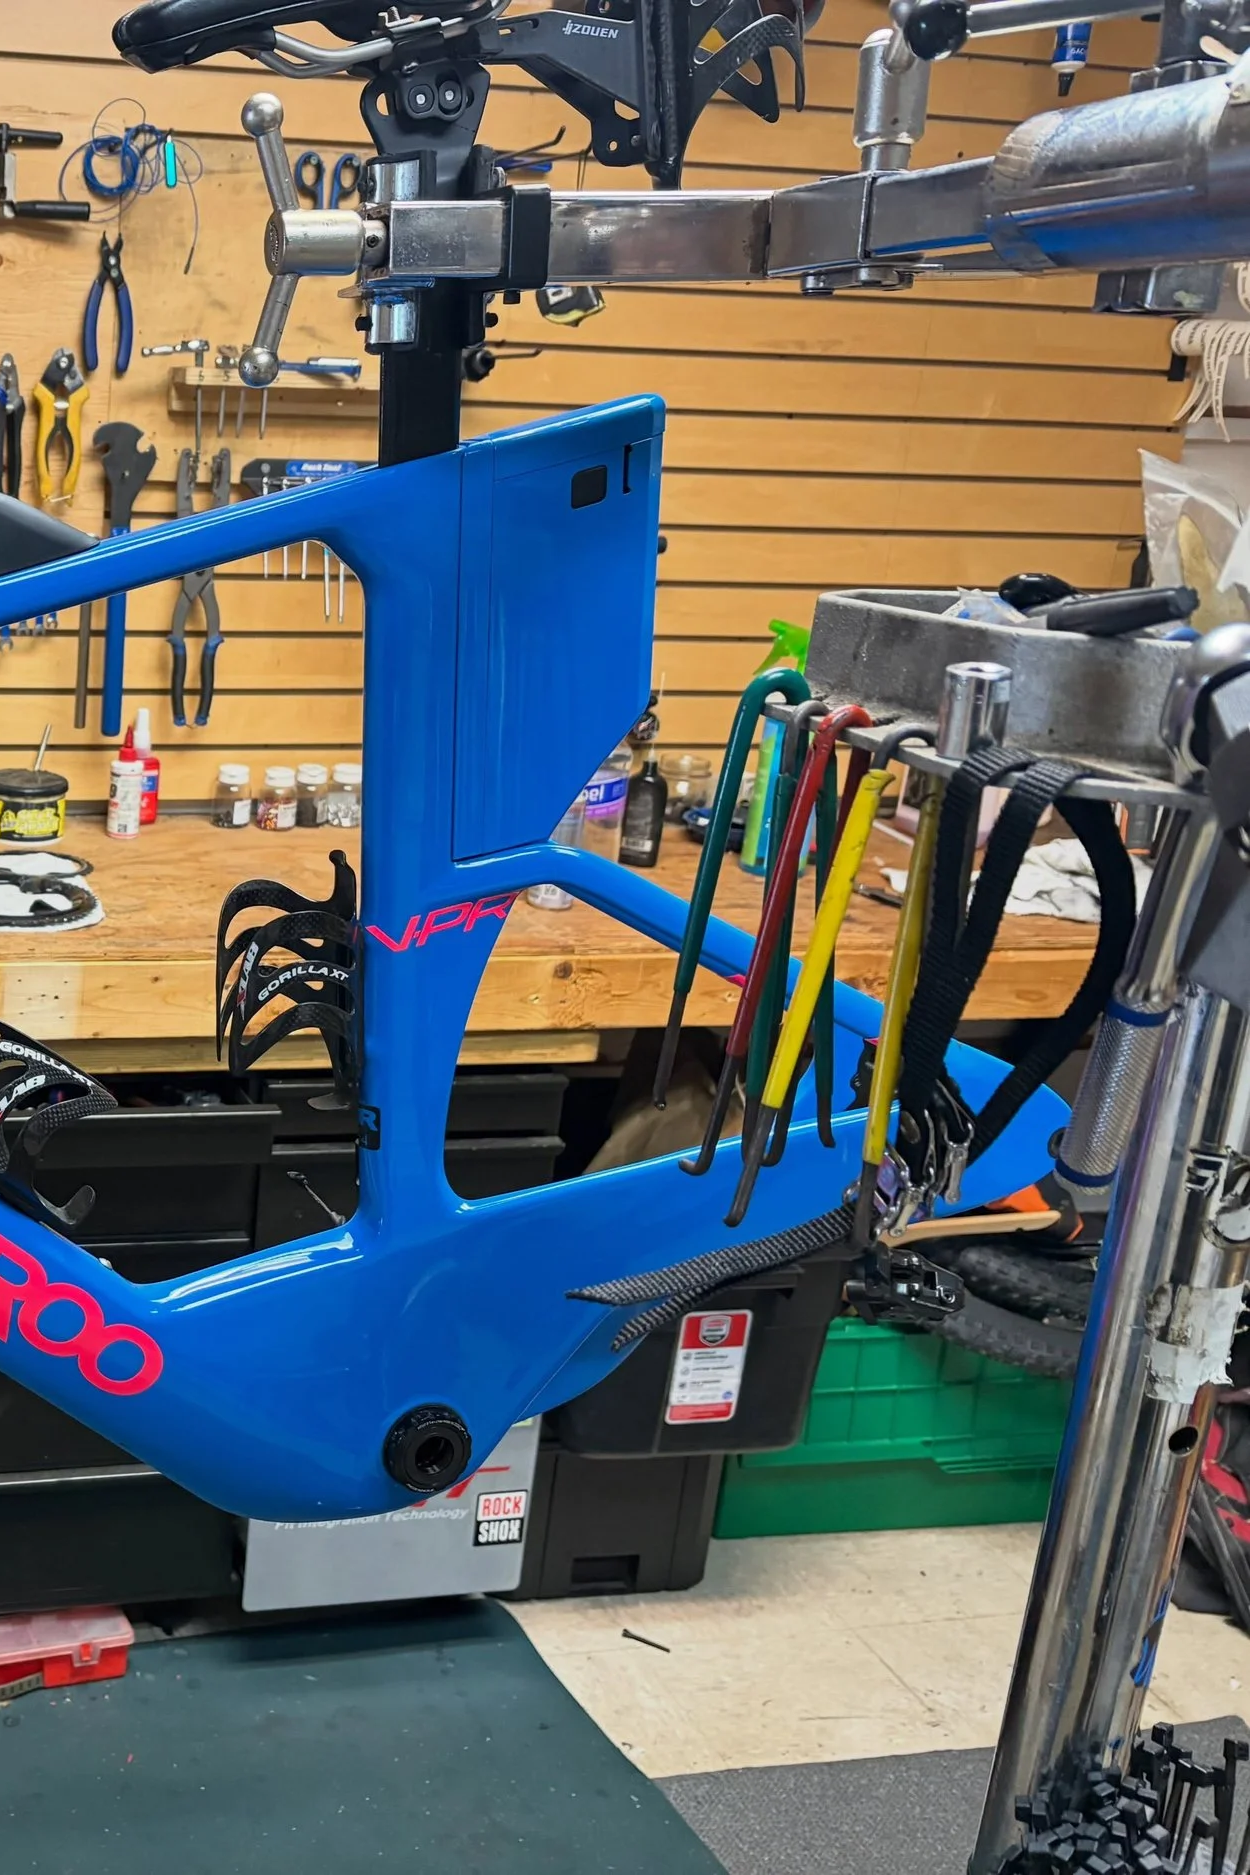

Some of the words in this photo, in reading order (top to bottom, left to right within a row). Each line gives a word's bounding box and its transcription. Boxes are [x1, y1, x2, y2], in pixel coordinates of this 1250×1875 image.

[257, 964, 329, 1002] GORILLA
[329, 967, 350, 982] XT
[384, 1505, 470, 1523] Technology
[481, 1495, 523, 1518] ROCK
[478, 1518, 522, 1544] SHOX
